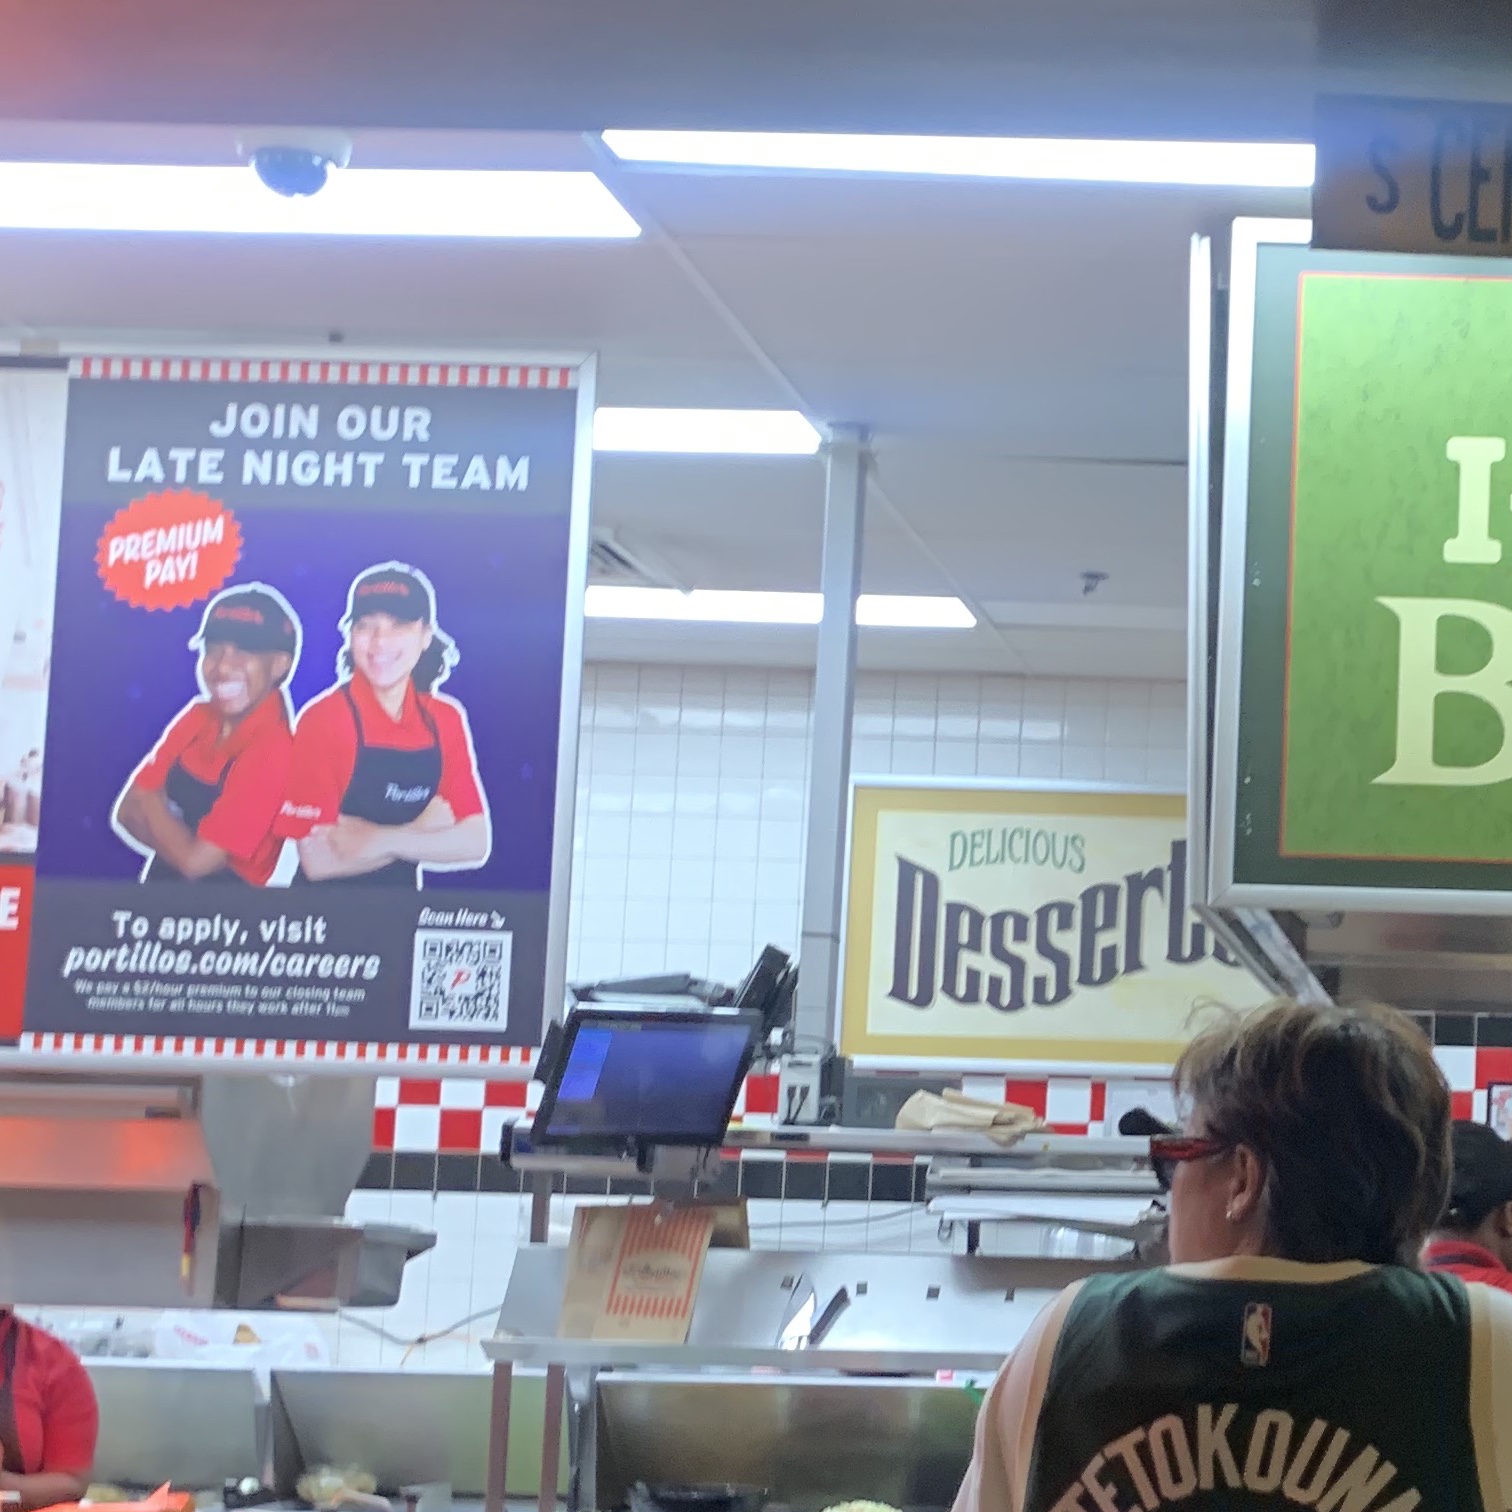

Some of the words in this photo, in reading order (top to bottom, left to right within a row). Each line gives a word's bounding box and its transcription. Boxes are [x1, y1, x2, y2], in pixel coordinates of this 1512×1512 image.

[1365, 136, 1401, 215] S
[209, 402, 319, 440] JOIN
[336, 405, 432, 442] OUR
[106, 446, 225, 483] LATE
[242, 449, 384, 488] NIGHT
[402, 453, 530, 491] TEAM
[108, 514, 225, 567] PREMIUM
[144, 551, 198, 590] PAY!
[947, 826, 1086, 873] DELICIOUS
[113, 909, 149, 939] To
[158, 913, 248, 947] apply,
[259, 914, 327, 944] visit
[418, 907, 455, 927] Scan
[455, 908, 489, 928] Here
[63, 940, 381, 980] portillos.com/careers
